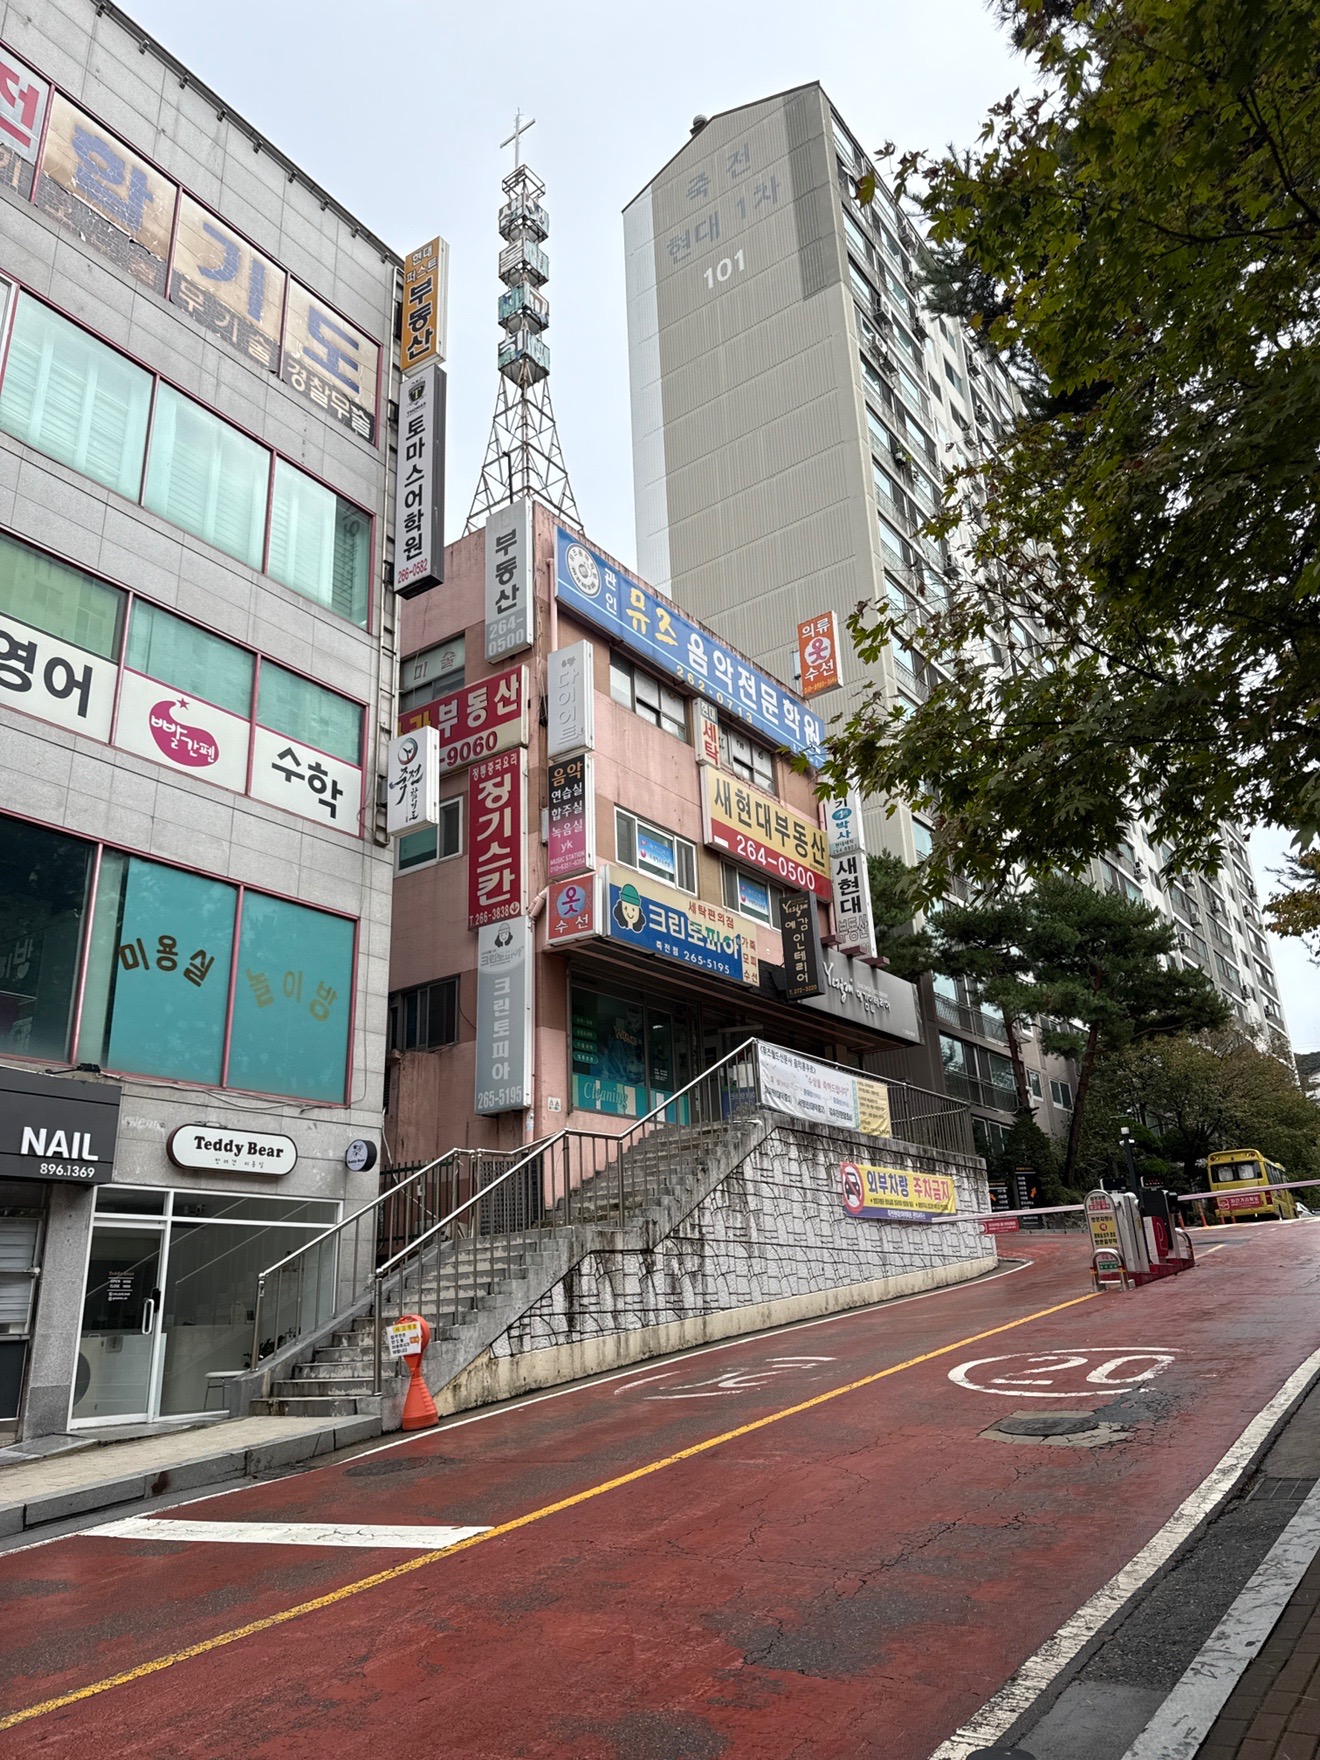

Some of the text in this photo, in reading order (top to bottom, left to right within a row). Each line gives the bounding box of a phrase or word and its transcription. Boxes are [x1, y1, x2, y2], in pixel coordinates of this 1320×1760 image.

[666, 210, 721, 265] 현대
[406, 257, 437, 282] 퍼스트
[413, 245, 433, 266] 현대
[703, 249, 745, 289] 101
[407, 276, 434, 361] 부동산
[288, 359, 371, 440] 경찰무술
[404, 414, 426, 562] 토마스어학원
[397, 557, 428, 584] 266-0582
[495, 528, 520, 615] 부동산
[605, 568, 617, 616] 관인
[625, 587, 679, 647] 뮤즈
[802, 618, 831, 638] 의류
[488, 628, 525, 657] 0500
[808, 638, 829, 665] 옷
[0, 629, 93, 718] 영어
[805, 659, 835, 682] 수선
[151, 714, 216, 763] 빨간펜
[703, 719, 719, 765] 세탁
[471, 752, 518, 782] 정통중국요리
[551, 761, 583, 788] 음악
[271, 746, 344, 819] 수학
[551, 782, 583, 804] 연습실
[551, 800, 583, 822] 합주실
[714, 778, 826, 868] 새현대부동산
[476, 772, 516, 907] 징기스칸
[551, 818, 583, 839] 녹음실
[835, 820, 852, 840] 박사
[736, 834, 815, 890] 264-0500
[836, 856, 862, 914] 새현대
[562, 886, 581, 915] 옷
[688, 901, 734, 929] 세탁편의점
[554, 913, 589, 934] 수선
[648, 904, 739, 960] 크린토피아
[838, 913, 870, 944] 부동산
[118, 934, 215, 988] 미용실
[683, 951, 730, 975] 265-5195
[491, 976, 511, 1081] 크린토피아
[477, 1085, 523, 1109] 265-5195
[583, 1081, 628, 1110] Cleaning
[20, 1126, 99, 1161] NAIL
[194, 1135, 284, 1158] Teddy Bear
[39, 1162, 96, 1179] 896.1369
[866, 1169, 951, 1202] 외부차량 주차금지
[988, 1355, 1175, 1384] 20
